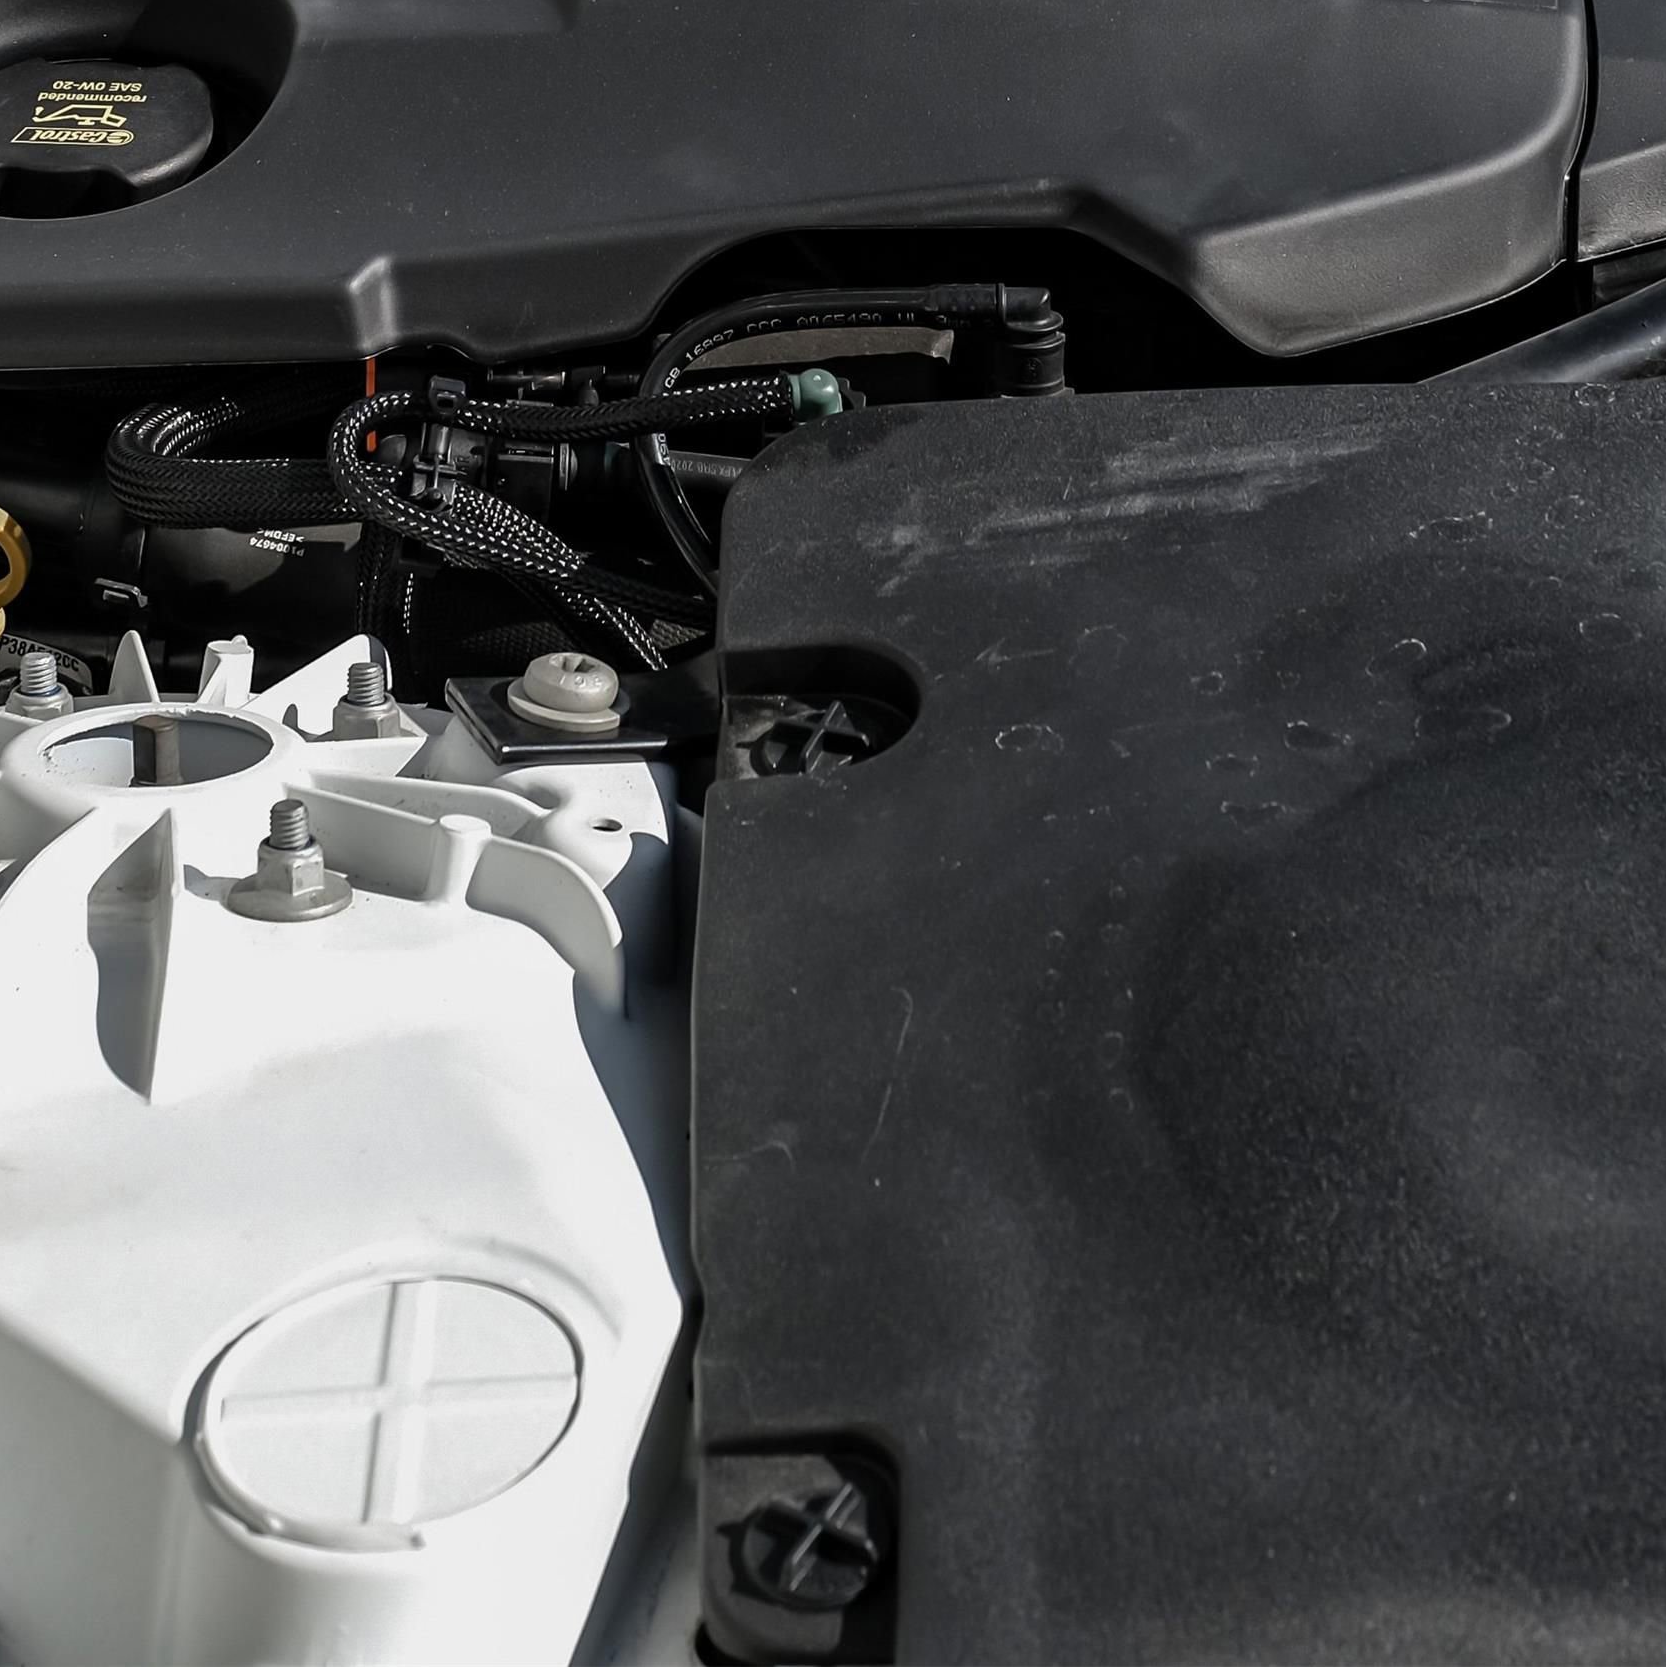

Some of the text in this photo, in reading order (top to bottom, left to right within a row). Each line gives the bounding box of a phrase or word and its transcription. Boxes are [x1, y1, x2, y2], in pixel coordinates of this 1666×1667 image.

[52, 80, 142, 92] SAE 0W-20
[37, 92, 148, 103] recommended
[29, 129, 108, 143] Castrol
